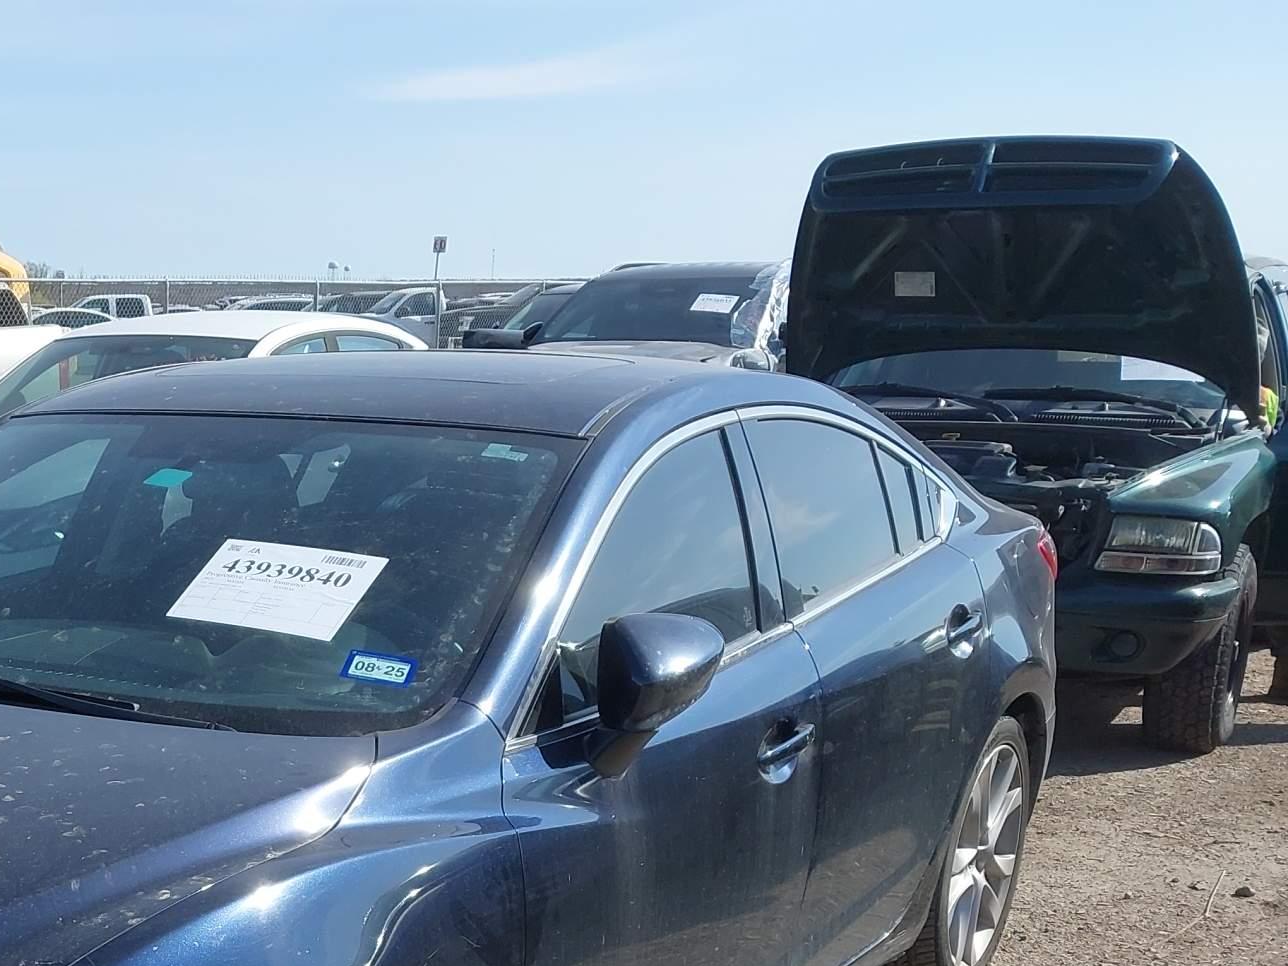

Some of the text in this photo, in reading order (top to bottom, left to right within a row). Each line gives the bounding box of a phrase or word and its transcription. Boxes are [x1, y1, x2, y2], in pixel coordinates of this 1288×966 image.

[222, 558, 353, 588] 43939840
[354, 660, 406, 678] 08 25
